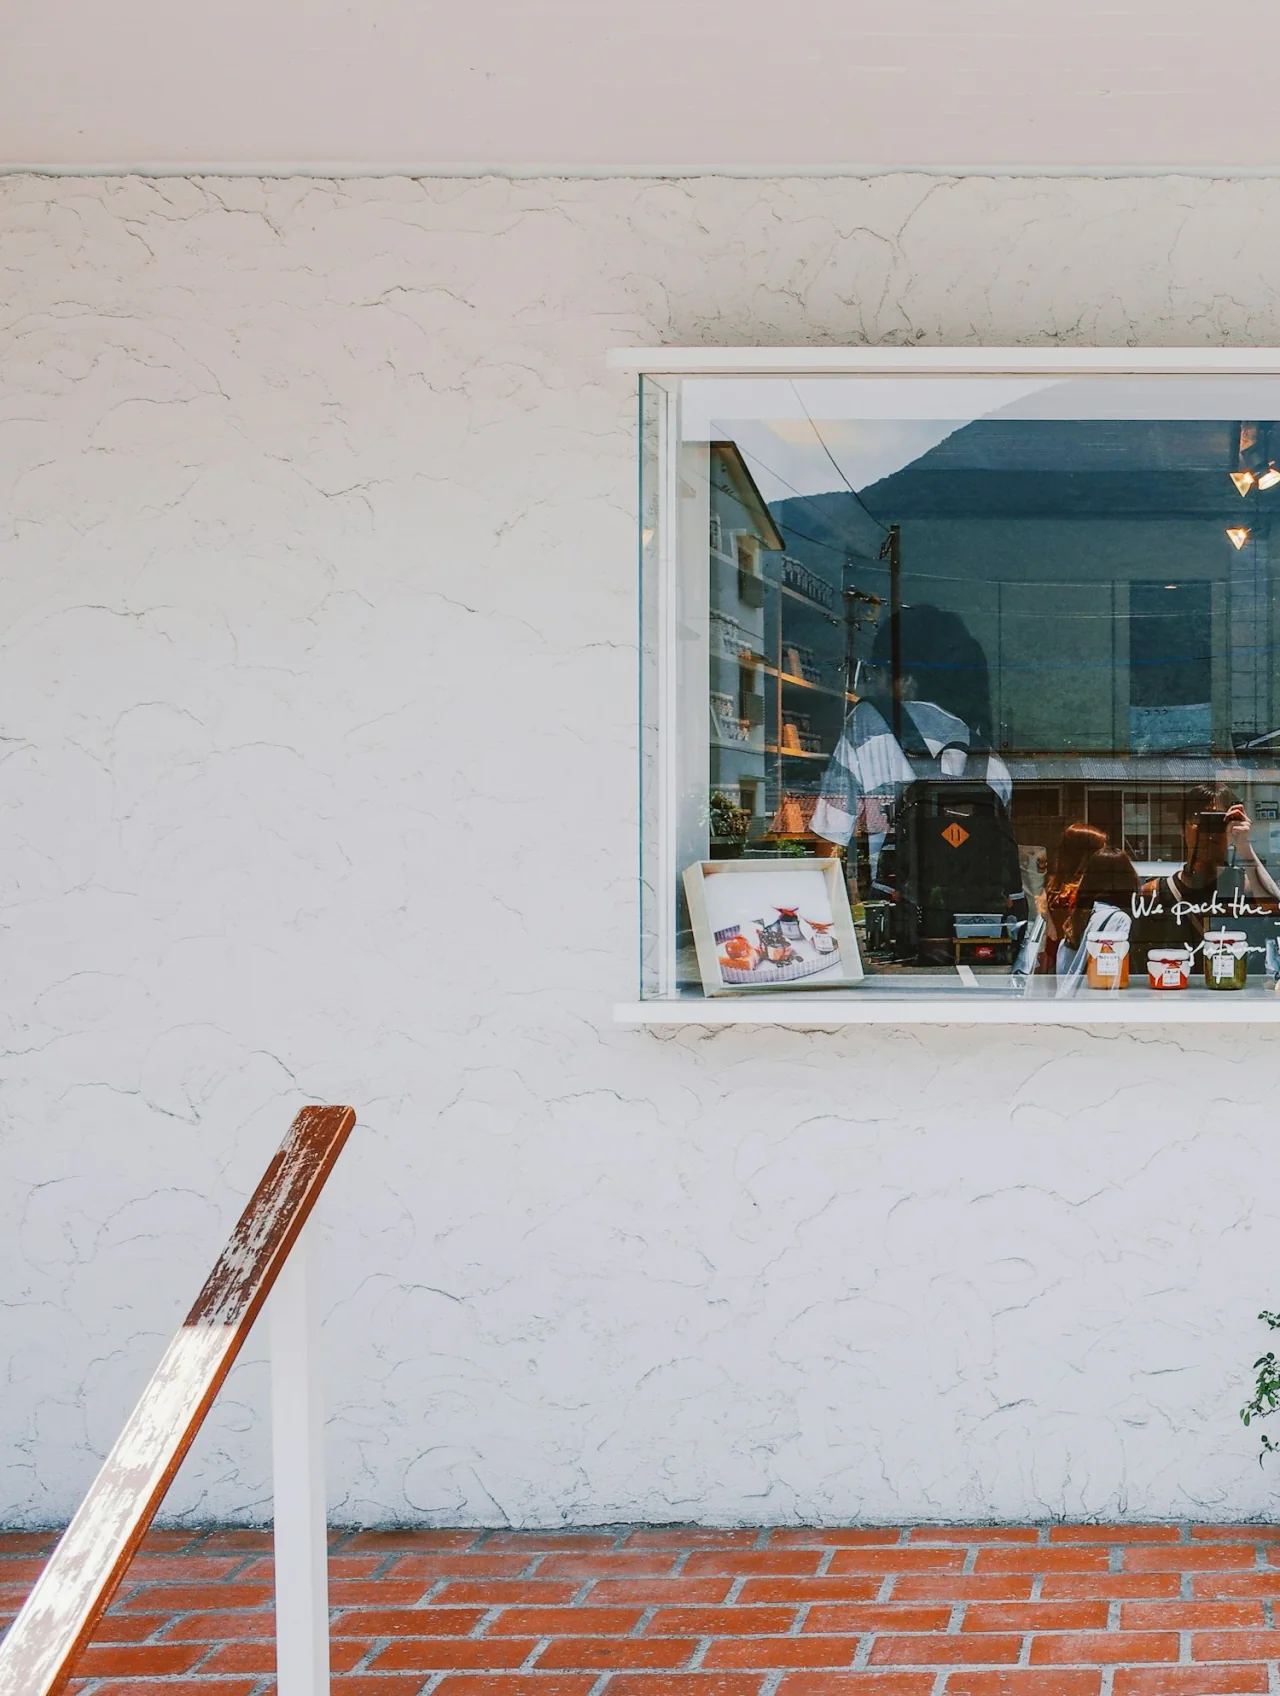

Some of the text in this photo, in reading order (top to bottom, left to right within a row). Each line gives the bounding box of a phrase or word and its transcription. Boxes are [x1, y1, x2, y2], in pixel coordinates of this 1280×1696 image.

[1131, 888, 1164, 918] We
[1171, 890, 1226, 925] pack
[1226, 886, 1272, 916] the
